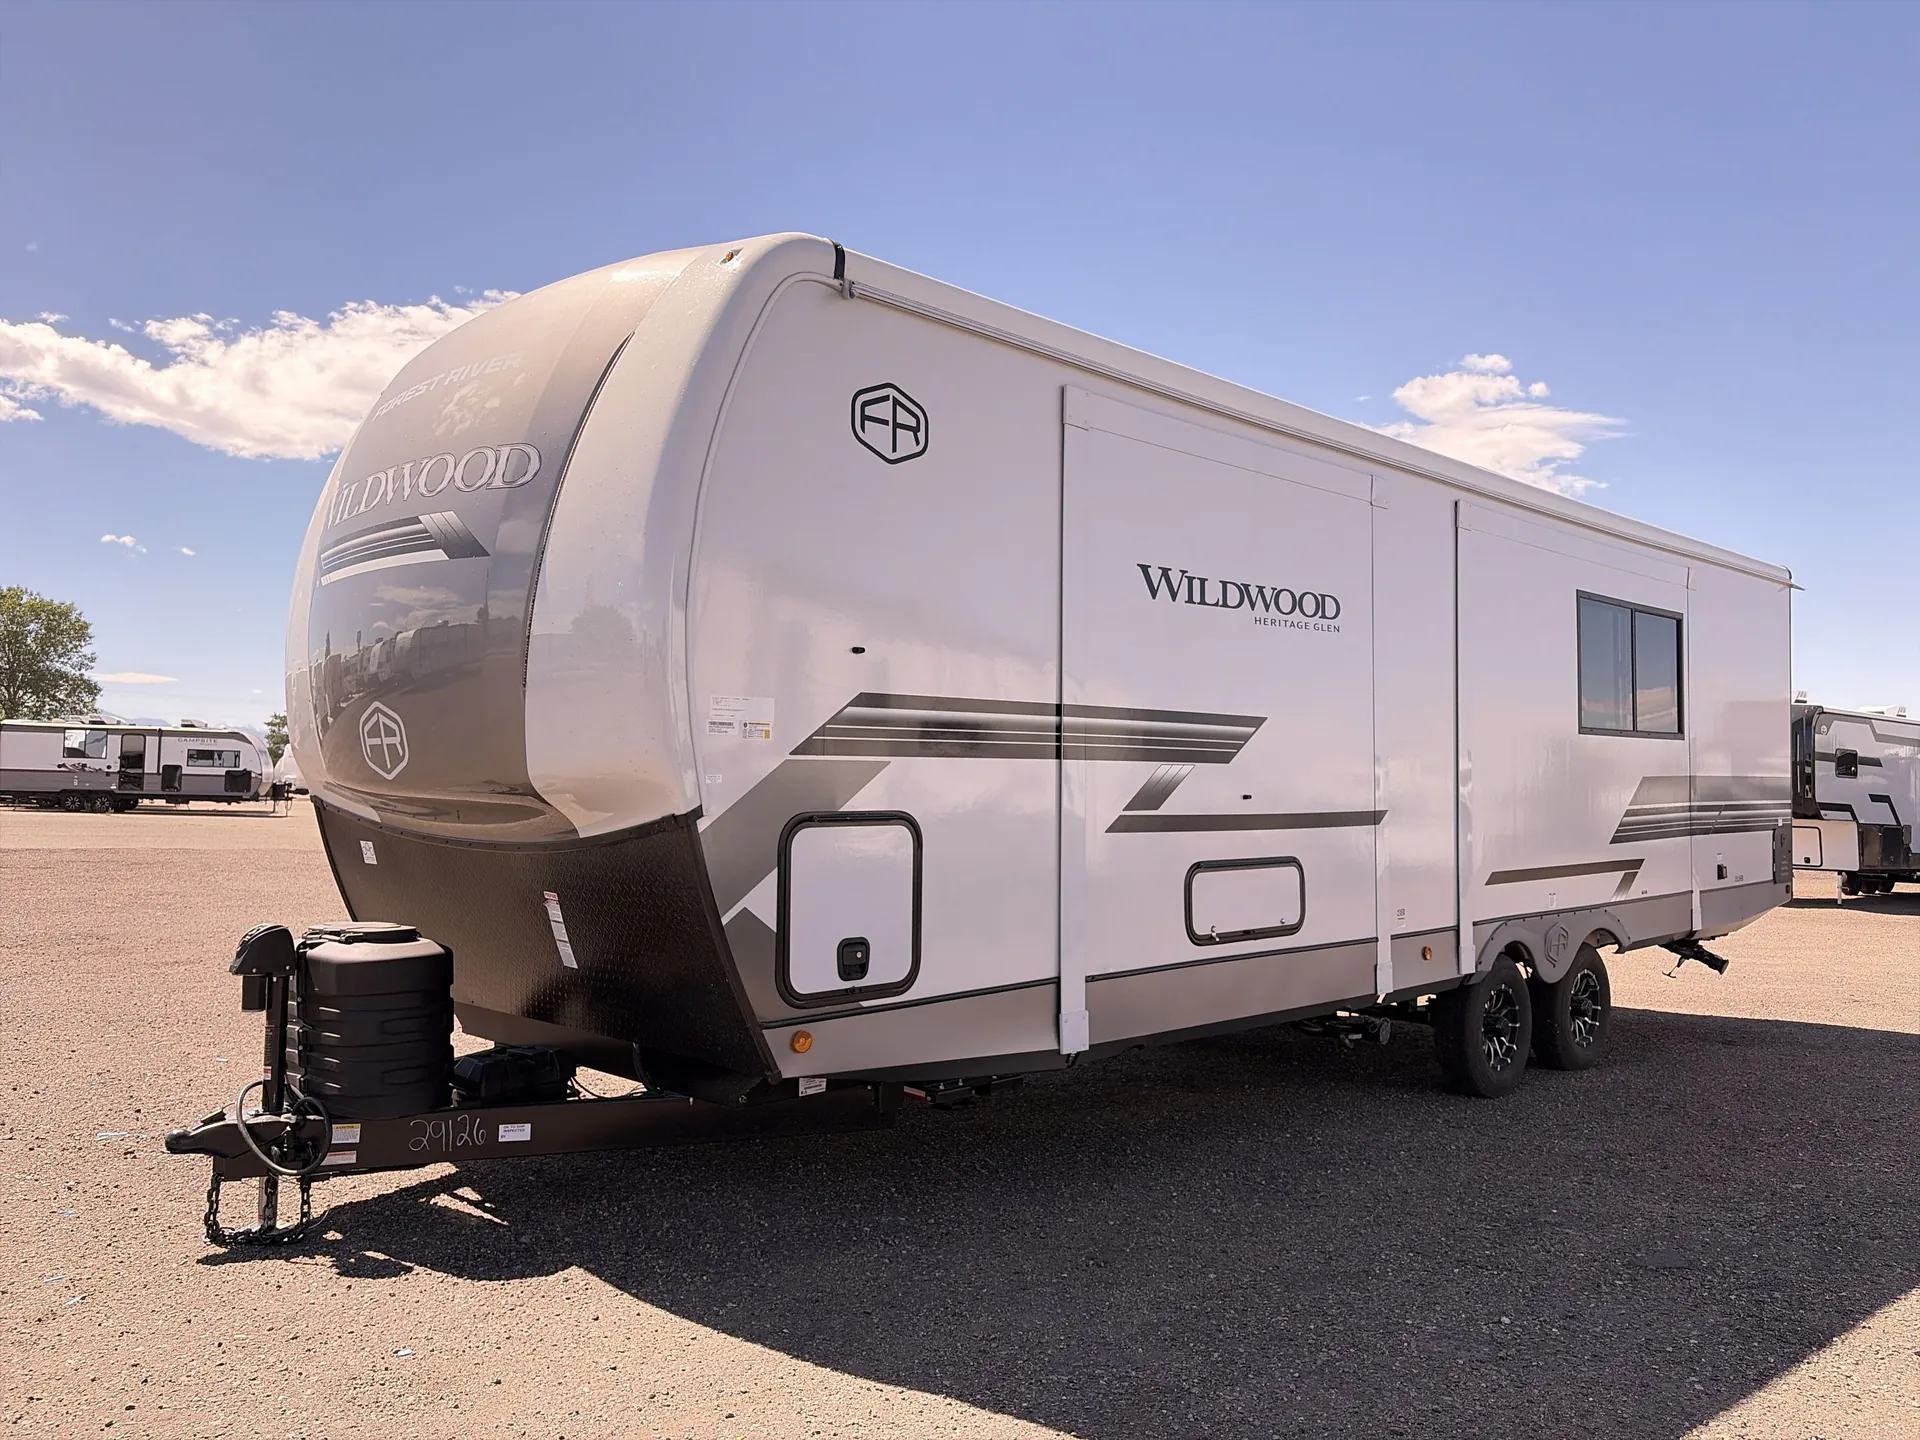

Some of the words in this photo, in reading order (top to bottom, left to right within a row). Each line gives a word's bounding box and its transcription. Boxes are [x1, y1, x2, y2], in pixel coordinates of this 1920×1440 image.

[371, 374, 446, 422] FOREST
[443, 351, 526, 386] RIVER
[1254, 616, 1310, 631] HERITAGE
[1313, 622, 1341, 633] GLEN
[408, 1113, 487, 1152] 29126
